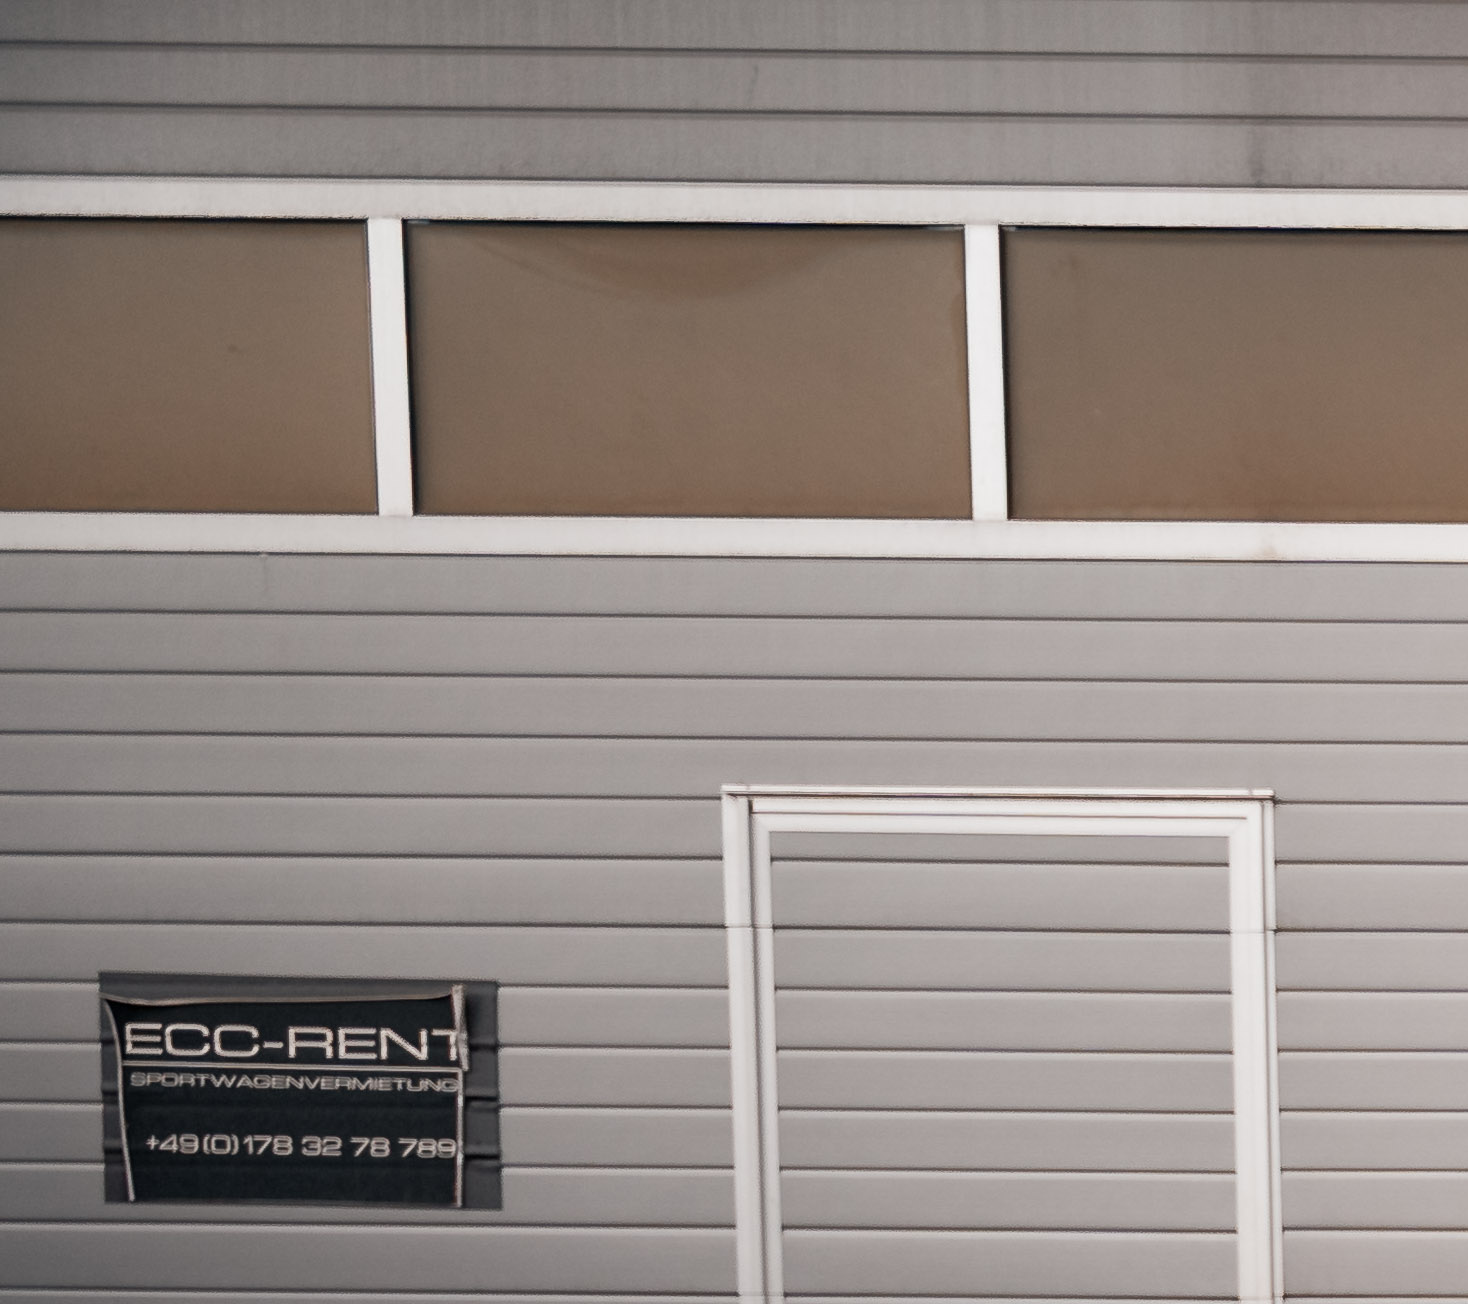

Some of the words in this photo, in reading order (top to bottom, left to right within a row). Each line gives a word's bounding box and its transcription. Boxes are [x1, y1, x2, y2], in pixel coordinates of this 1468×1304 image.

[124, 1022, 458, 1061] ECC-RENT
[130, 1071, 459, 1093] SPORTWAGENVERMIETUNG
[301, 1135, 343, 1157] 32
[350, 1136, 391, 1158] 78
[398, 1137, 457, 1159] 789
